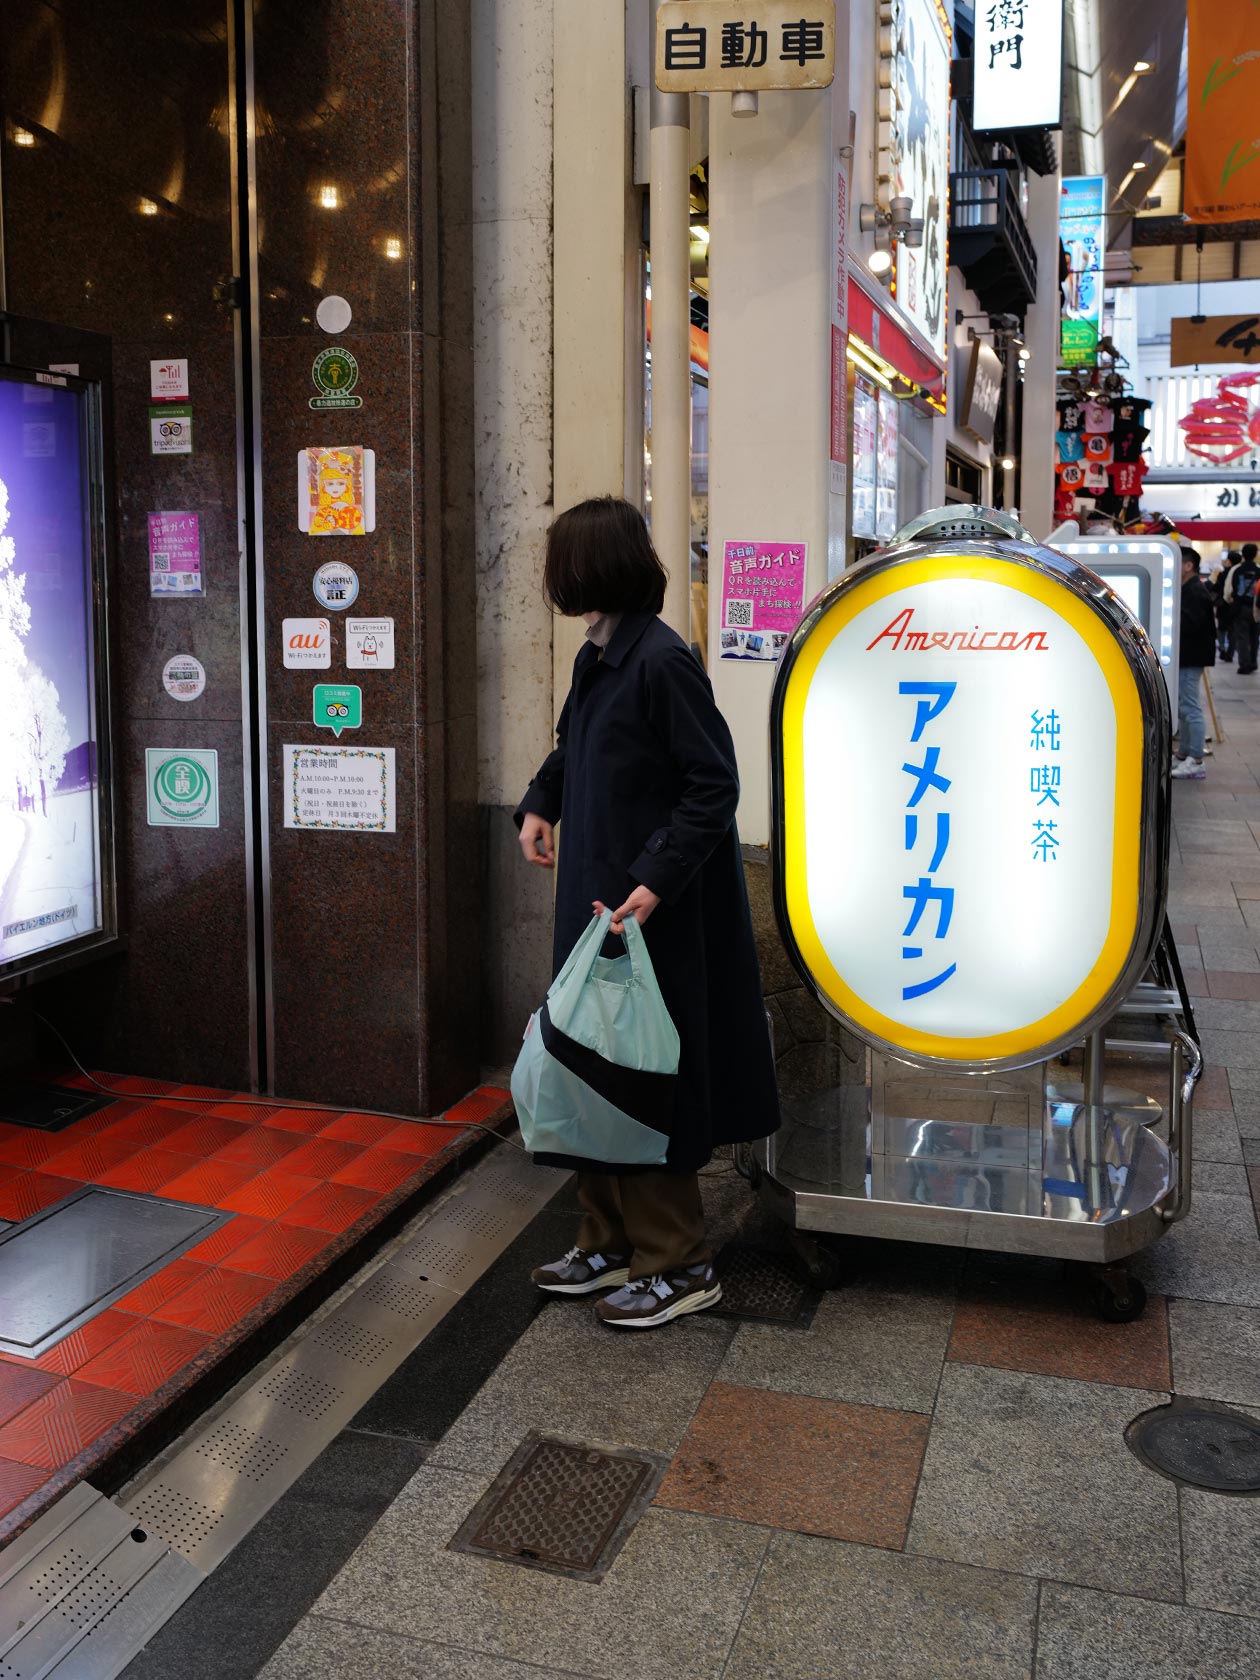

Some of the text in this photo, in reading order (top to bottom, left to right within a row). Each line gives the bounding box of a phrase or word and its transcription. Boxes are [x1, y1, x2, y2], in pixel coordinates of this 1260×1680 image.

[665, 18, 826, 70] 自動車
[985, 0, 1028, 70] 衛門
[728, 546, 755, 559] 千日前
[730, 549, 800, 575] 音声ガイド
[727, 587, 778, 597] スマホ片手に
[289, 633, 325, 649] au
[866, 608, 1049, 651] American
[300, 758, 338, 769] 営業時間
[301, 787, 332, 795] 火曜日のみ
[1030, 708, 1061, 862] 純喫茶
[899, 681, 957, 1001] アメリカン
